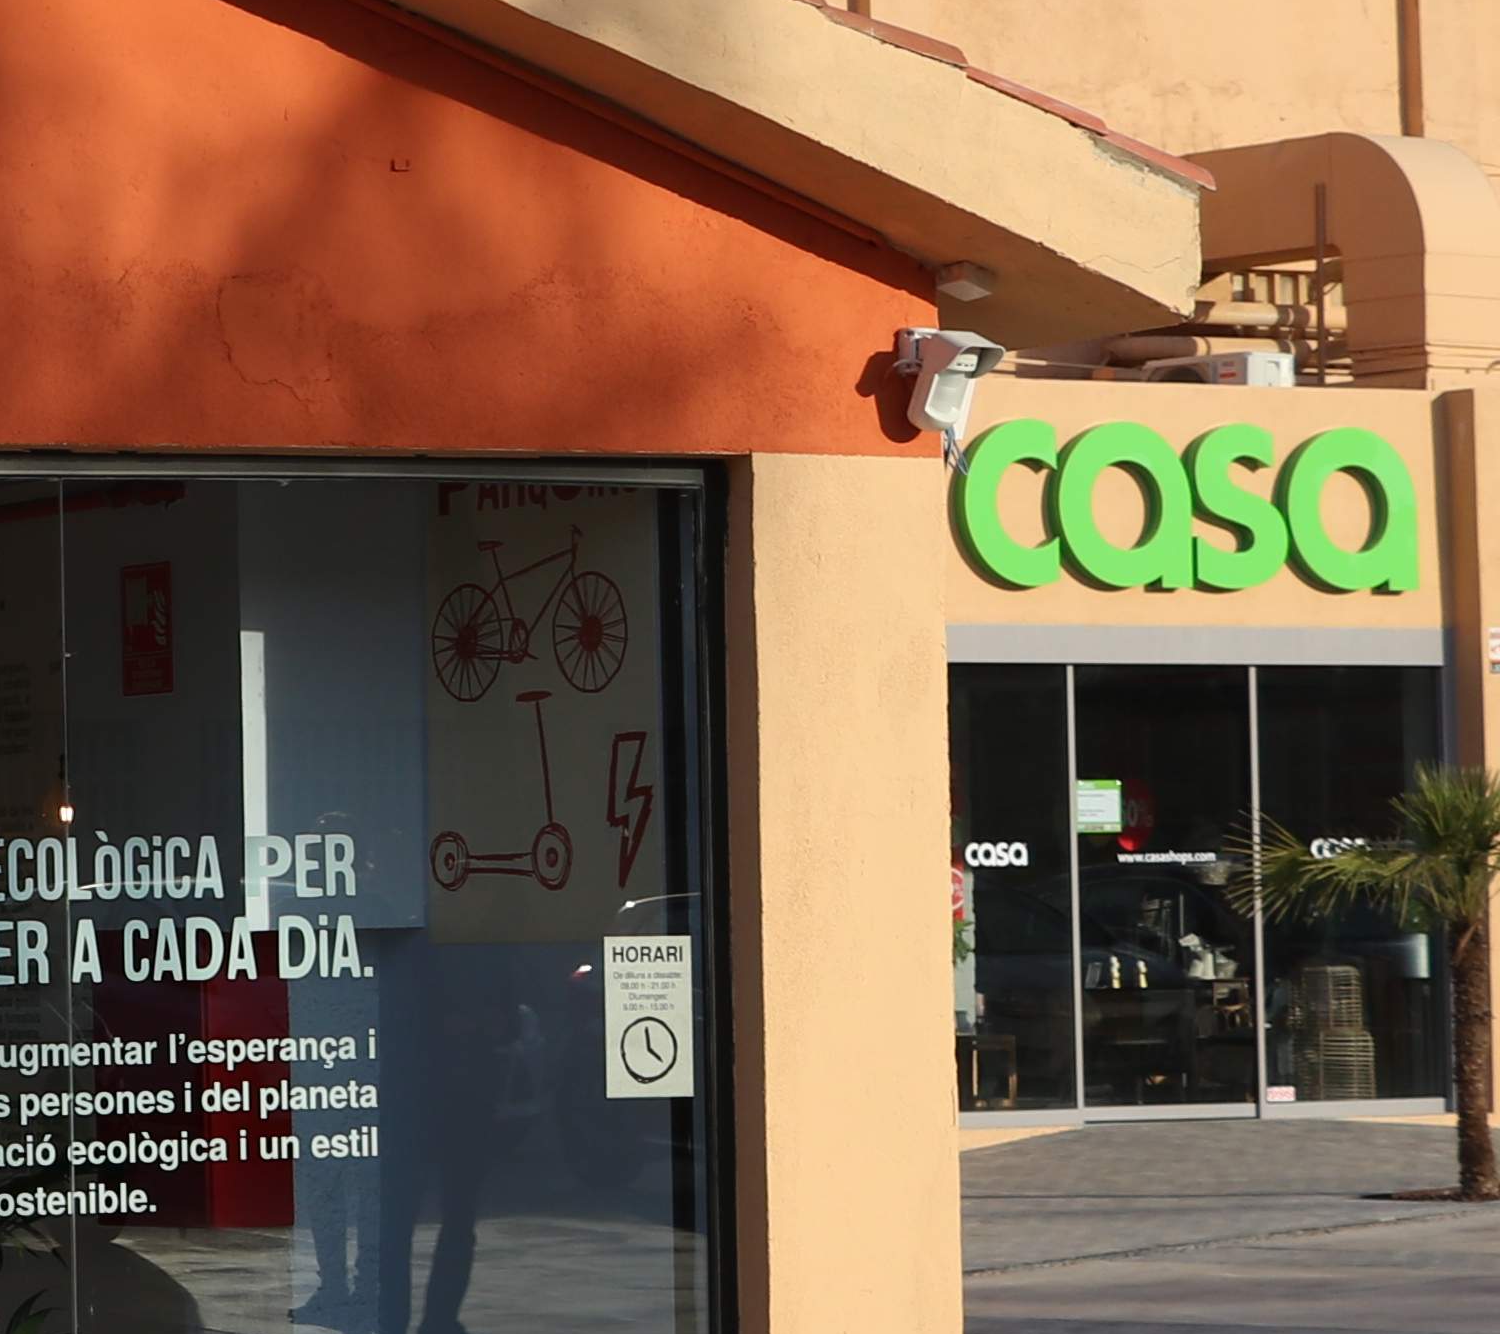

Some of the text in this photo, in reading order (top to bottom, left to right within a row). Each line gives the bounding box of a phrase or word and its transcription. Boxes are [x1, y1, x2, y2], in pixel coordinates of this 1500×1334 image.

[961, 417, 1419, 593] casa
[248, 832, 357, 898] PER
[964, 841, 1029, 867] casa
[1116, 850, 1217, 865] www.casashops.com
[71, 921, 101, 985] A
[122, 916, 258, 984] CADA
[612, 946, 683, 963] HORARI
[367, 1028, 378, 1060] i
[19, 1085, 176, 1125] persones
[183, 1082, 193, 1115] i
[200, 1080, 251, 1114] del
[258, 1078, 379, 1118] planeta
[66, 1130, 227, 1176] ecològica
[237, 1128, 248, 1161] i
[258, 1134, 302, 1161] un
[310, 1125, 380, 1159] estil
